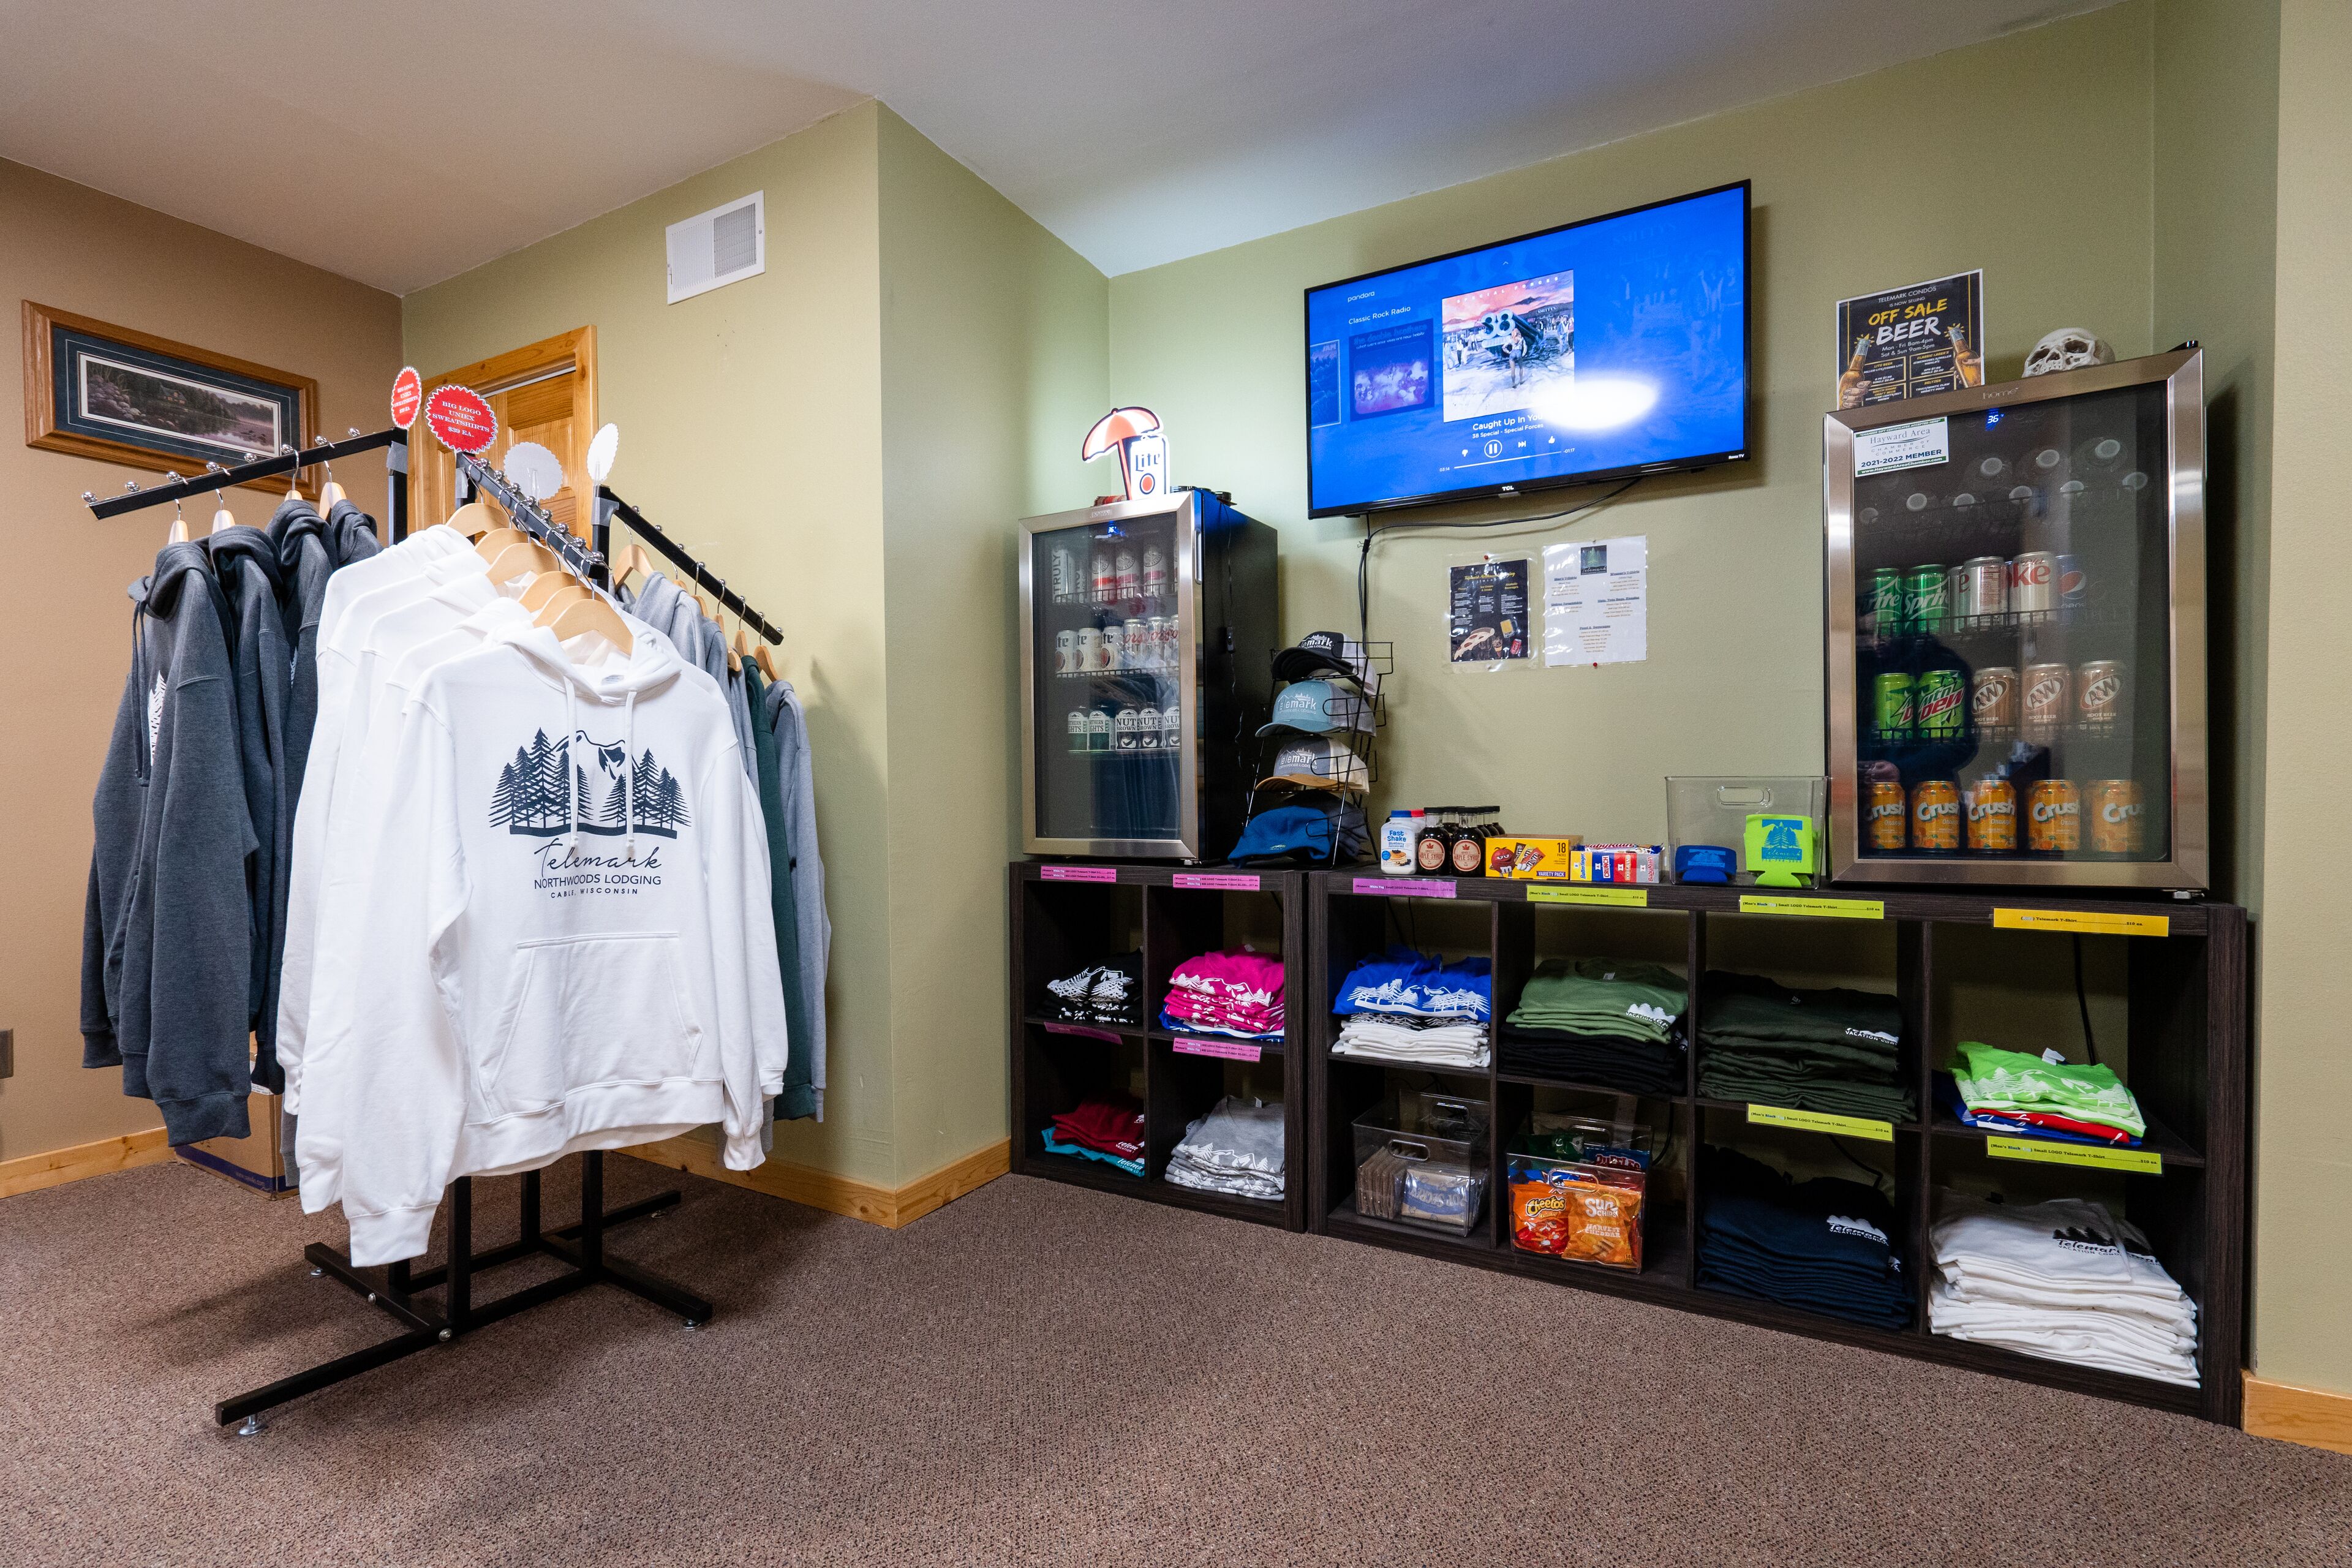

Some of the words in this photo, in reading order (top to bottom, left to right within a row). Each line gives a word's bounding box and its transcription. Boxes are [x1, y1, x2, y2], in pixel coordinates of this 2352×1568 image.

[1348, 292, 1374, 303] pandora
[1457, 289, 1504, 303] SPECIAL
[1514, 277, 1558, 290] FORCES
[1878, 293, 1906, 303] TELEMARK
[1909, 287, 1936, 296] CONDOS
[1349, 315, 1370, 324] Classic
[1391, 306, 1411, 315] Radio
[1868, 309, 1900, 326] OFF
[1904, 298, 1948, 319] SALE
[1481, 309, 1515, 339] 38
[1876, 317, 1941, 345] BEER
[1908, 338, 1933, 347] 8am-4pm
[449, 410, 475, 421] UNIEX
[459, 405, 481, 415] LOGO
[432, 413, 489, 432] SWEATSHIRTS
[1472, 420, 1502, 431] Caught
[1988, 415, 1999, 423] 36
[1870, 431, 1907, 444] Hayward
[1872, 442, 1913, 452] CHAMBER
[1876, 445, 1924, 456] COMMERCE
[1861, 456, 1903, 467] 2021-2022
[1906, 450, 1942, 459] MEMBER
[1861, 458, 1942, 473] www.HaywardAreaChamber.com
[1975, 680, 2000, 711] A&W
[2030, 678, 2056, 709] A&W
[2089, 676, 2117, 707] A&W
[1969, 799, 2015, 821] Crush
[1557, 843, 1566, 853] 18
[534, 838, 662, 877] Telemark
[534, 874, 600, 889] NORTHWOODS
[605, 875, 661, 885] LODGING
[1626, 1012, 1653, 1022] VACATION
[1845, 1030, 1878, 1041] VACATION
[1116, 1144, 1131, 1152] VACATION
[1527, 1196, 1565, 1216] Cheetos
[1585, 1198, 1618, 1217] Sun
[1585, 1229, 1621, 1238] CHEDDAR
[1830, 1223, 1889, 1246] Telemark
[2058, 1245, 2095, 1254] VACATION
